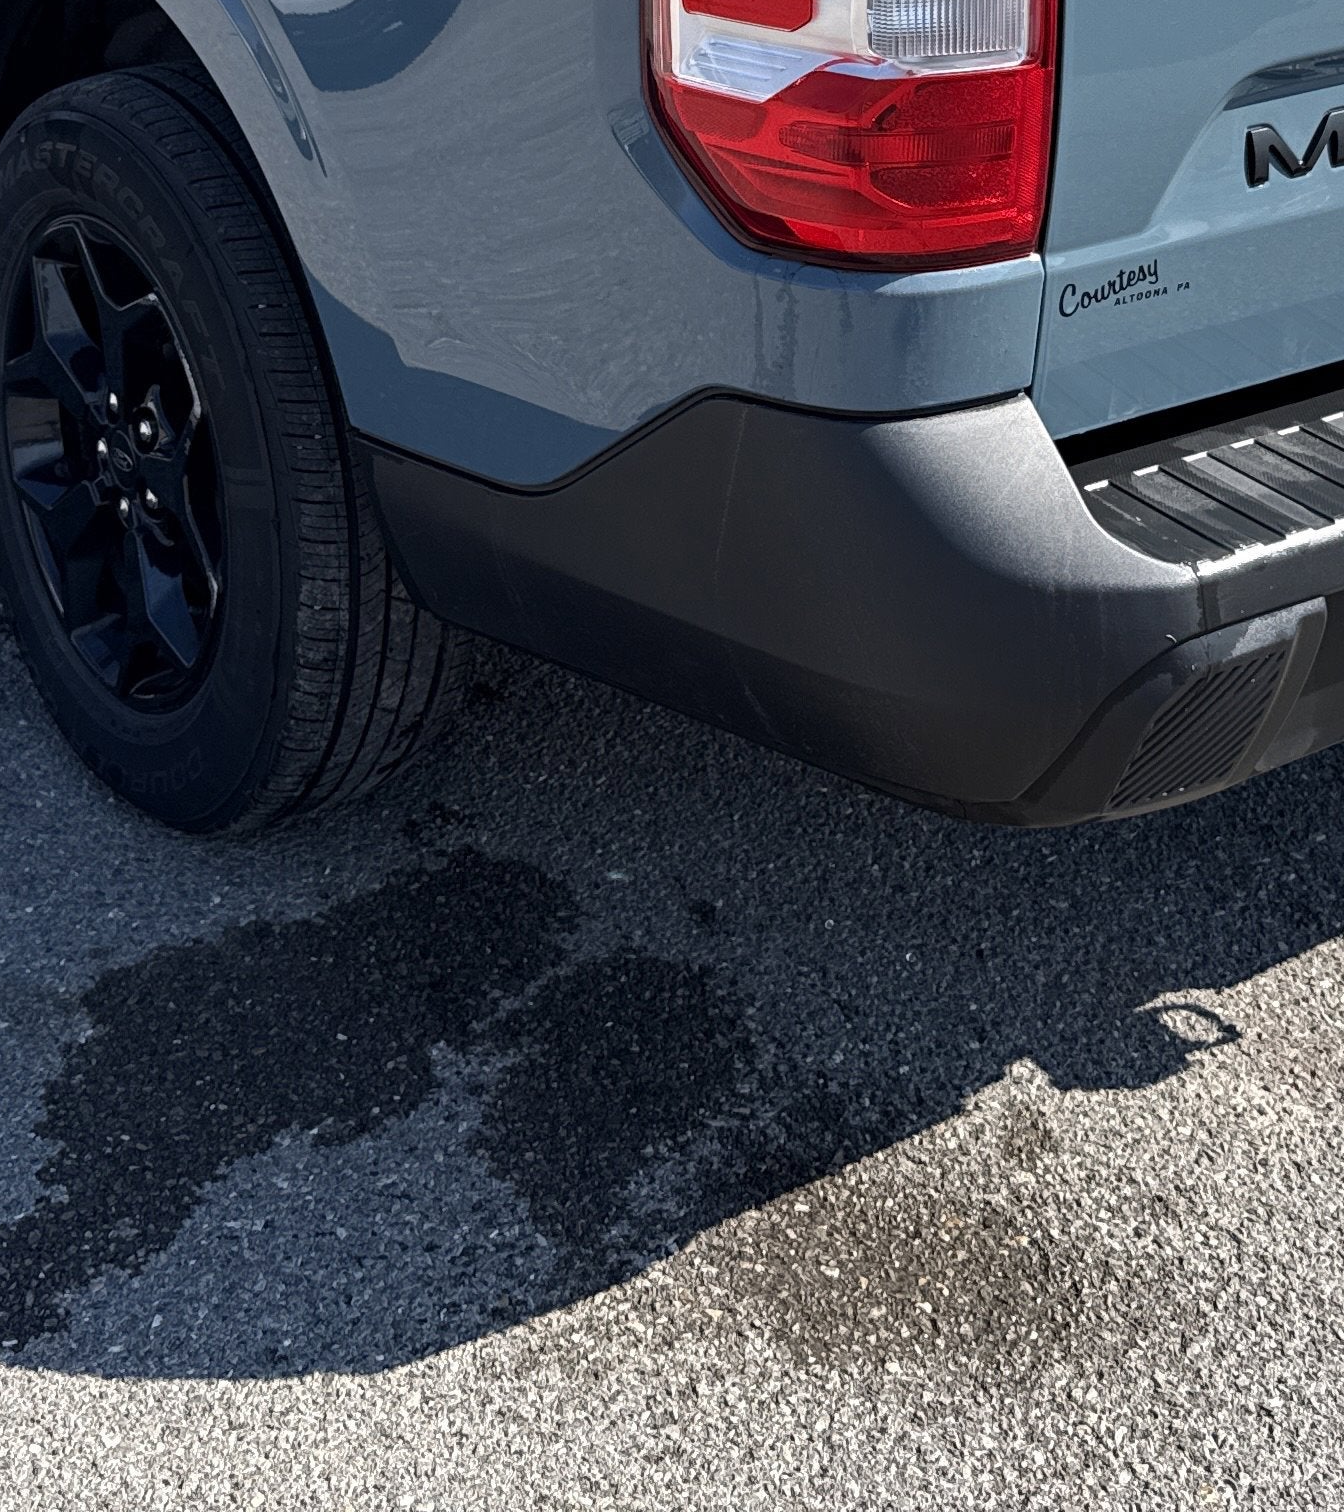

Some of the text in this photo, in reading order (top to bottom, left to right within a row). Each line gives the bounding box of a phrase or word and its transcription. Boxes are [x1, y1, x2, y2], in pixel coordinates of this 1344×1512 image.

[1058, 258, 1159, 317] Courtesy
[1113, 281, 1190, 306] ALTOONA PA
